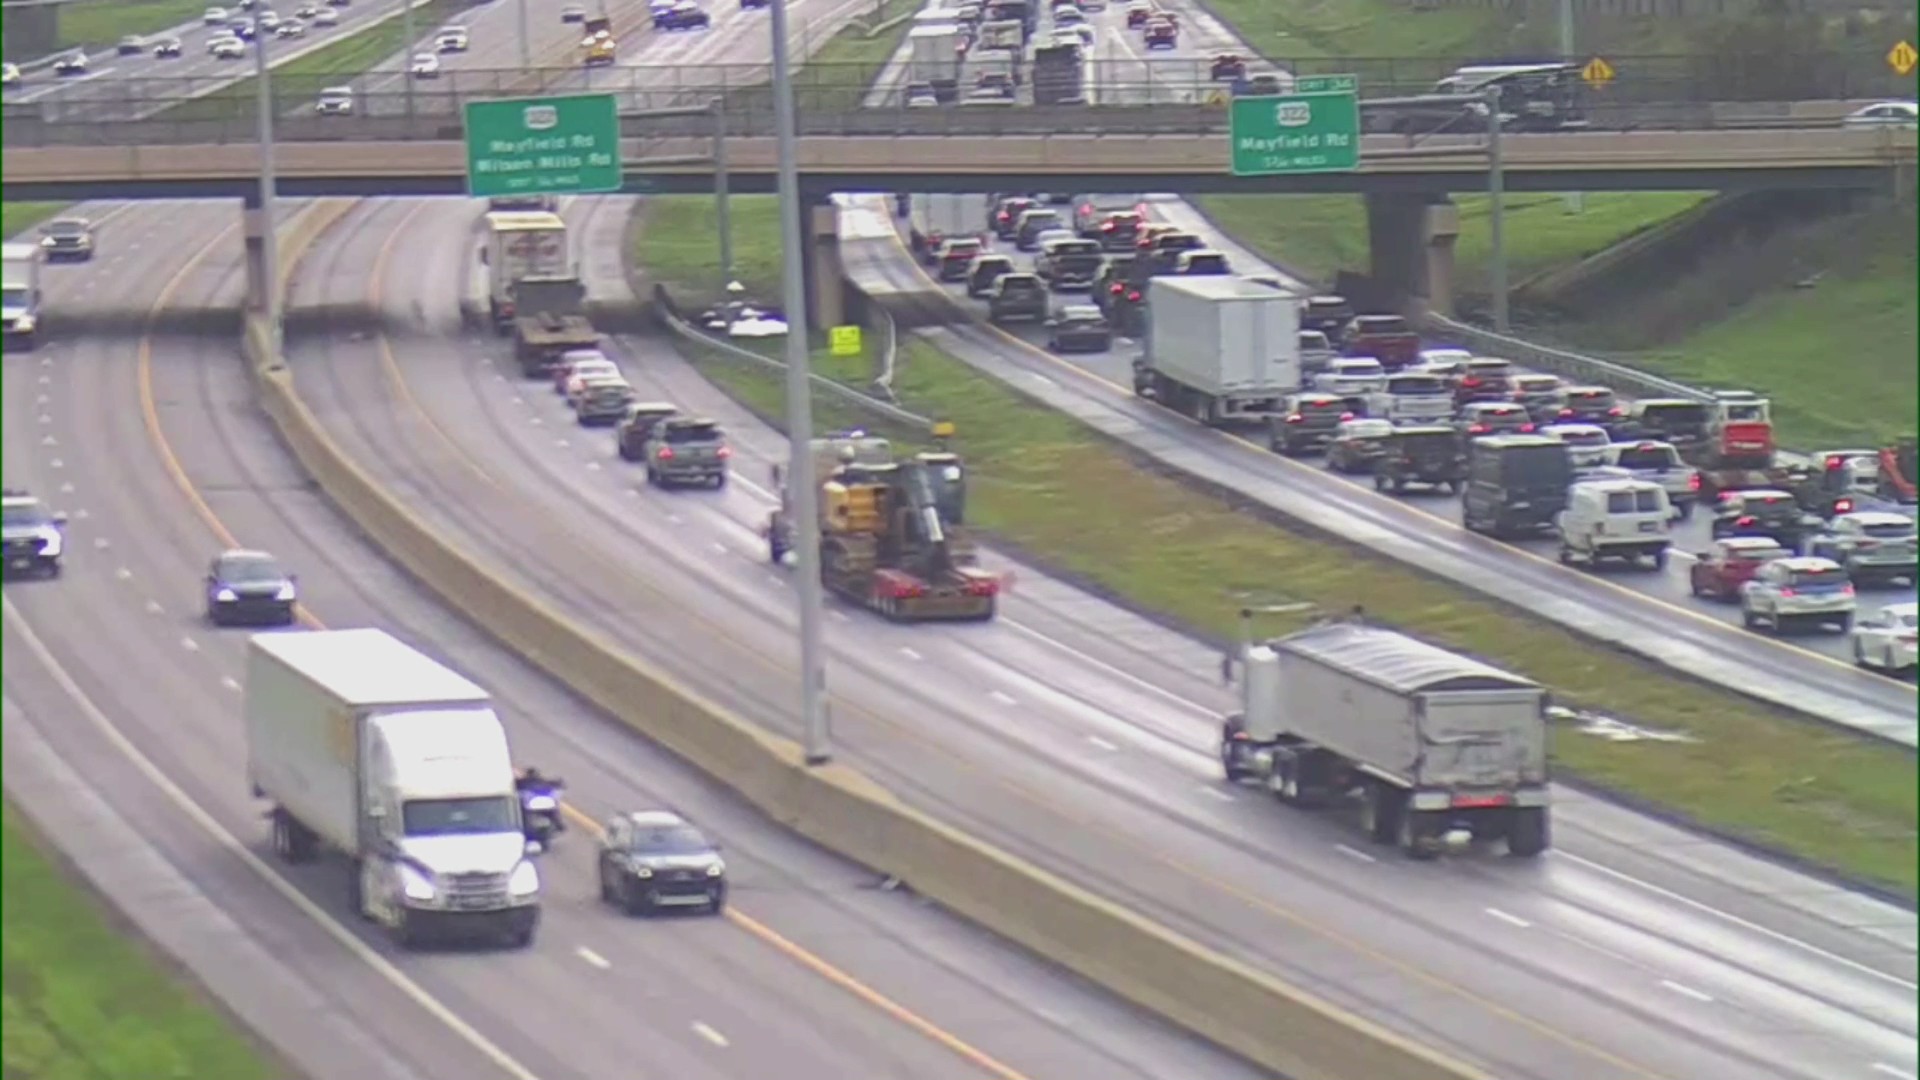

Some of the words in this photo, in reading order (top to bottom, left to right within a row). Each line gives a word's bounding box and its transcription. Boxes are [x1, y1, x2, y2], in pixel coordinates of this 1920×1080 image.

[490, 137, 566, 153] Mayfield
[571, 134, 595, 148] Rd
[1240, 135, 1319, 151] Mayfield
[1326, 133, 1349, 147] Rd
[588, 153, 611, 166] Rd
